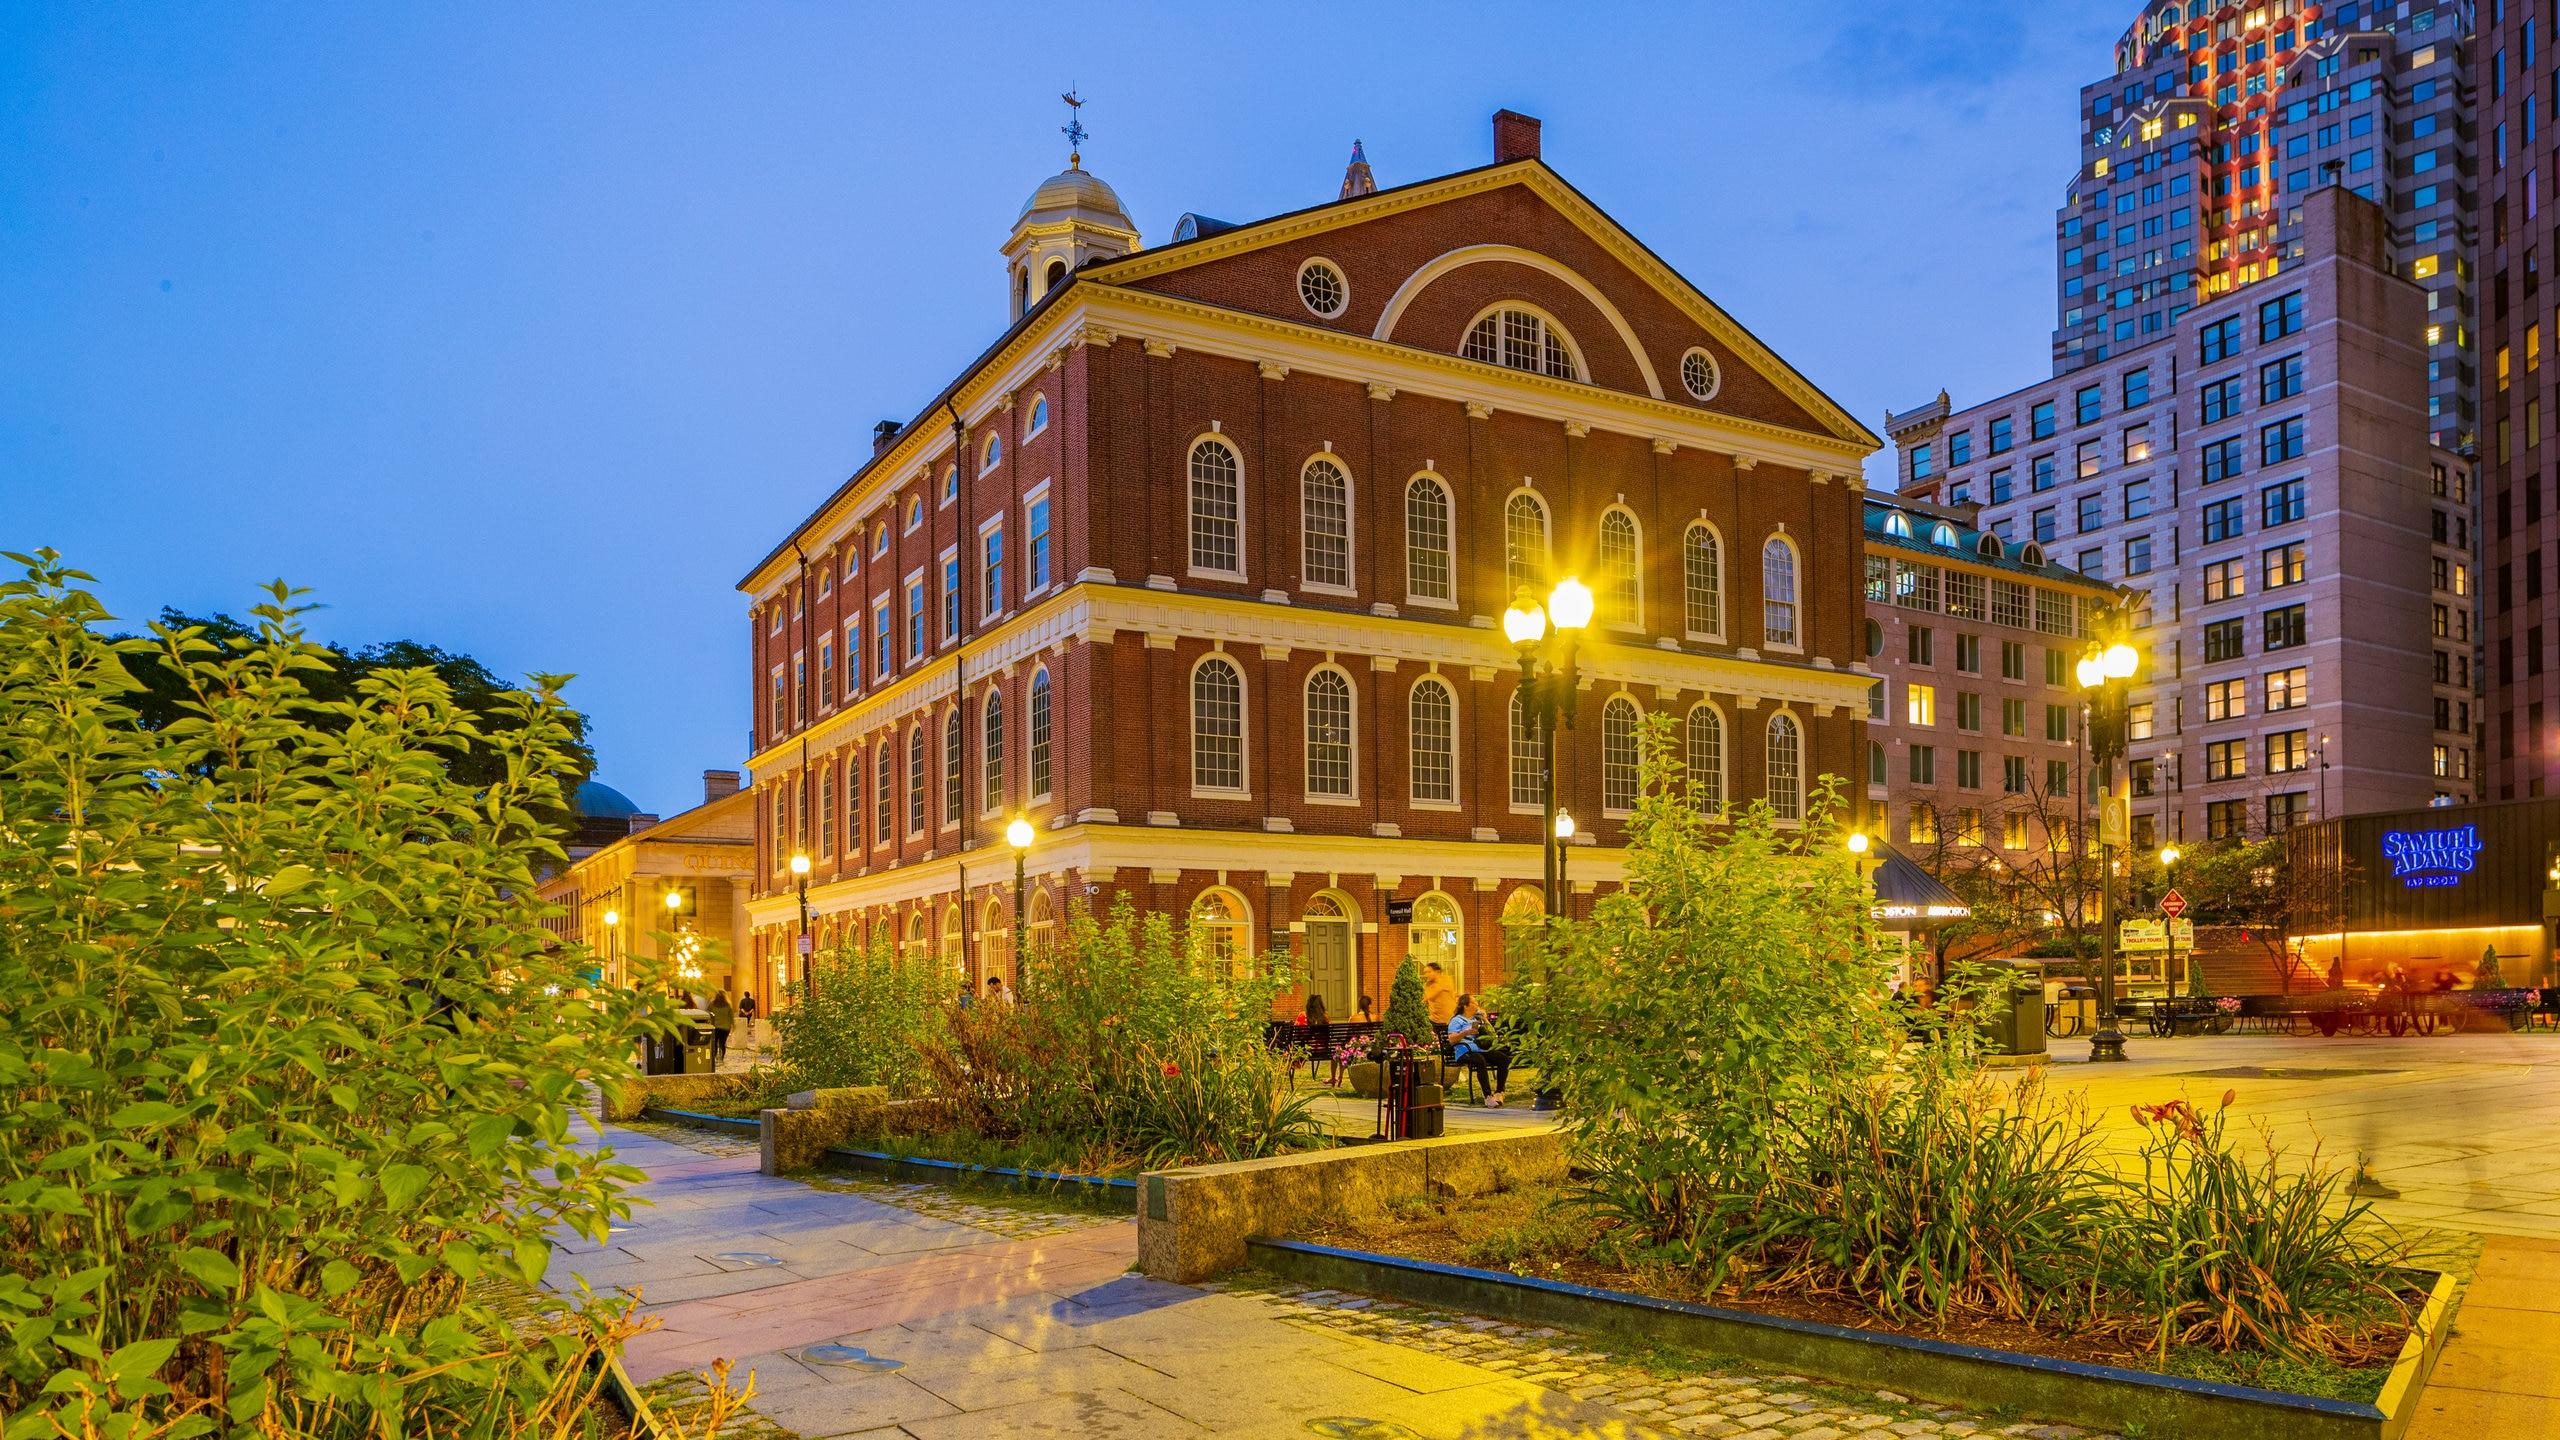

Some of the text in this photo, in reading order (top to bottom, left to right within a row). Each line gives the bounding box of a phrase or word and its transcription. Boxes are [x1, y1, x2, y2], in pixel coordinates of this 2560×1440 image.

[2383, 825, 2482, 857] SAMUEL
[2394, 848, 2474, 875] ADAMS
[2406, 876, 2458, 886] TAP ROOM
